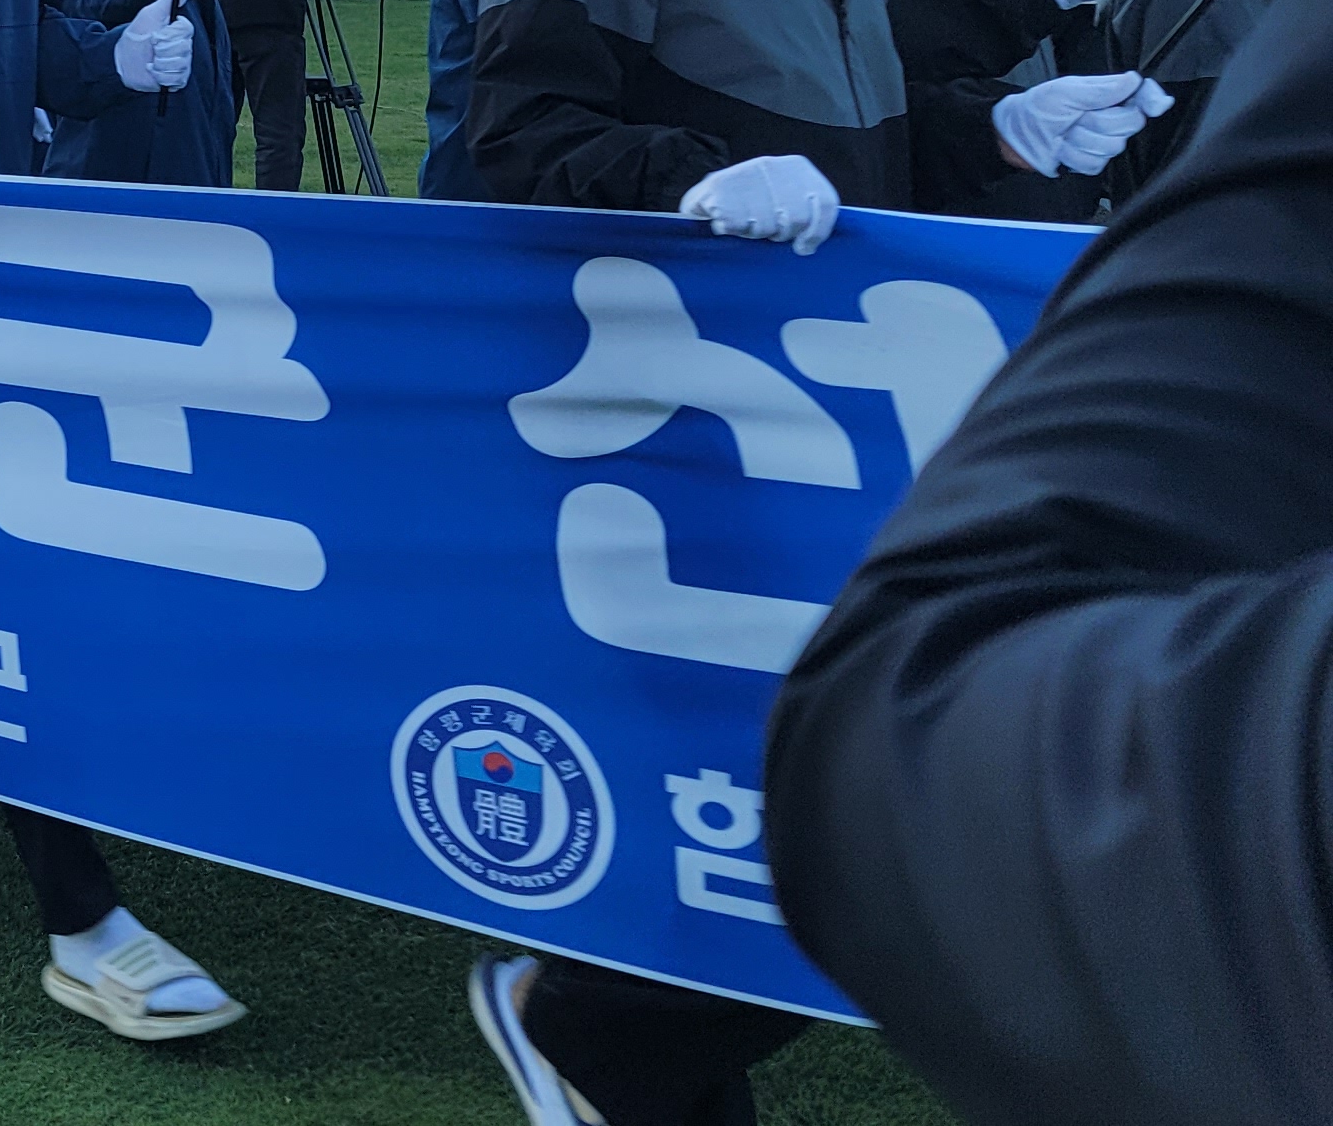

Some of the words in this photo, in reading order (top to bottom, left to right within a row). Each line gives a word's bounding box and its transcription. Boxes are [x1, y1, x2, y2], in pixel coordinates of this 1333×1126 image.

[417, 704, 582, 781] 함평군체육회
[411, 771, 486, 874] HAMPYEONG
[485, 869, 558, 889] SPORTS
[552, 807, 594, 878] COUNCIL
